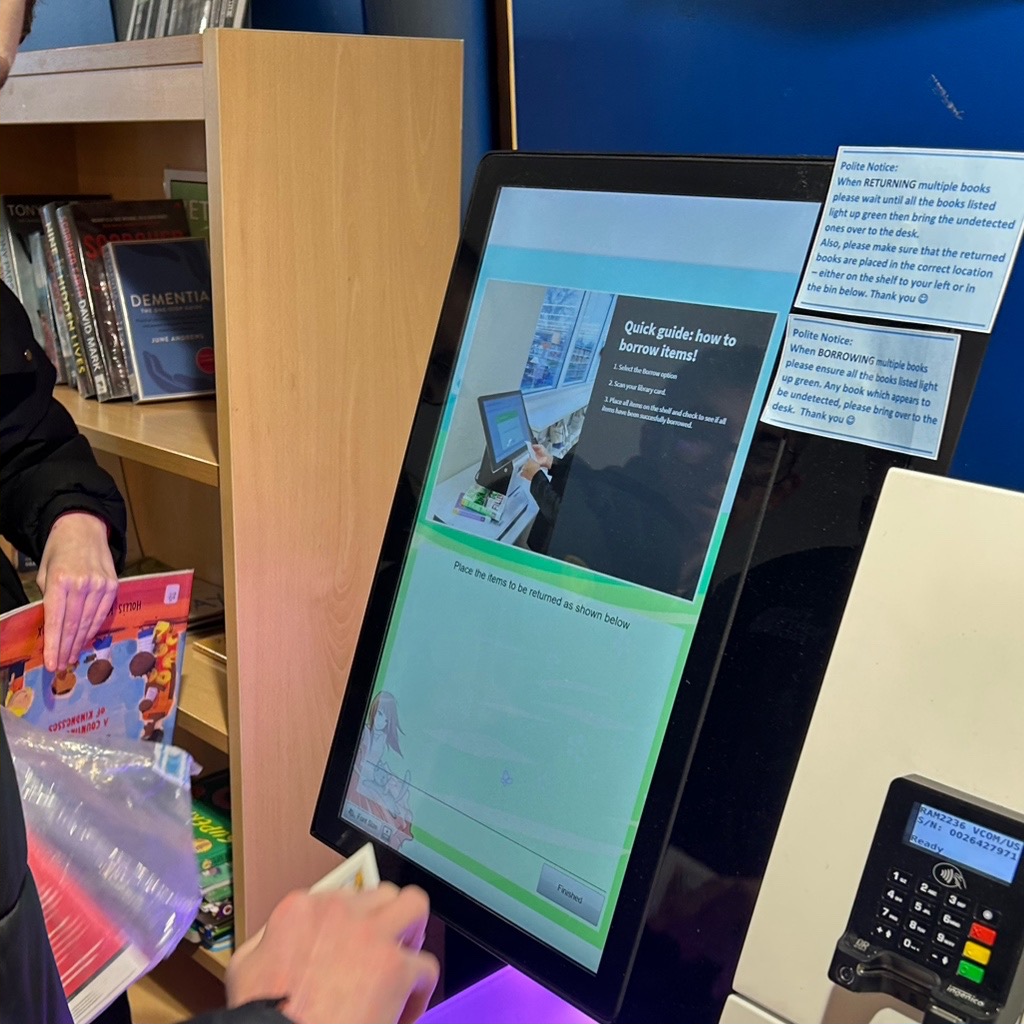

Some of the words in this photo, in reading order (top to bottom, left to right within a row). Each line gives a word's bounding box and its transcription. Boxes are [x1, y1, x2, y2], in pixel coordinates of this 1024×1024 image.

[840, 161, 865, 171] Polite
[866, 162, 898, 172] Notice:
[838, 177, 862, 186] When
[863, 177, 917, 189] RETURNING
[918, 181, 958, 193] multiple
[960, 182, 990, 193] books
[832, 193, 860, 203] please
[862, 195, 881, 203] wait
[882, 196, 904, 204] until
[904, 197, 917, 205] all
[918, 198, 934, 207] the
[936, 198, 965, 208] books
[967, 200, 997, 211] listed
[829, 208, 848, 218] light
[849, 210, 861, 220] up
[861, 211, 887, 220] green
[889, 212, 910, 221] then
[911, 213, 936, 225] bring
[938, 215, 954, 224] the
[956, 217, 1016, 229] undetected
[825, 224, 845, 232] ones
[846, 226, 866, 234] over
[868, 226, 877, 235] to
[879, 227, 894, 236] the
[895, 228, 919, 238] desk.
[820, 238, 840, 249] Also,
[842, 240, 871, 250] please
[872, 243, 896, 252] make
[898, 246, 918, 254] sure
[920, 246, 940, 256] that
[942, 248, 958, 258] the
[960, 250, 1006, 262] returned
[816, 252, 842, 263] books
[843, 257, 857, 265] are
[858, 257, 889, 268] placed
[889, 259, 898, 268] in
[900, 261, 915, 270] the
[917, 264, 951, 274] correct
[952, 265, 993, 278] location
[807, 282, 822, 292] the
[823, 283, 837, 294] bin
[838, 285, 867, 297] below.
[870, 289, 897, 300] Thank
[898, 294, 916, 303] you
[819, 269, 845, 279] either
[859, 273, 874, 282] the
[875, 275, 898, 284] shelf
[899, 277, 909, 286] to
[910, 279, 932, 289] your
[934, 280, 950, 290] left
[965, 283, 975, 293] in
[130, 290, 210, 308] DEMENTIA
[78, 299, 93, 334] DAVID
[86, 336, 101, 371] MARK
[625, 320, 656, 336] Quick
[656, 326, 694, 340] guide:
[695, 330, 722, 344] how
[723, 334, 736, 346] to
[792, 328, 818, 340] Polite
[820, 332, 853, 346] Notice:
[619, 339, 660, 356] borrow
[660, 345, 698, 362] items!
[790, 343, 816, 355] When
[818, 347, 875, 365] BORROWING
[876, 358, 905, 370] multiple
[906, 361, 928, 373] books
[785, 360, 814, 371] please
[815, 365, 845, 376] ensure
[846, 369, 858, 378] all
[859, 371, 874, 381] the
[875, 373, 897, 384] books
[898, 376, 918, 388] listed
[919, 379, 938, 392] light
[782, 375, 793, 384] up
[794, 377, 822, 388] green.
[823, 380, 841, 393] Any
[842, 383, 864, 395] book
[867, 388, 890, 400] which
[891, 393, 919, 405] appears
[921, 397, 931, 406] to
[772, 402, 795, 413] desk.
[800, 407, 827, 420] Thank
[828, 414, 844, 423] you
[777, 387, 789, 397] be
[843, 400, 871, 413] please
[873, 404, 894, 419] bring
[894, 410, 911, 420] over
[912, 412, 921, 422] to
[923, 414, 937, 424] the
[453, 561, 473, 575] Place
[474, 568, 486, 579] the
[487, 572, 507, 587] items
[508, 579, 516, 590] to
[517, 582, 527, 594] be
[529, 588, 562, 606] returned
[563, 600, 573, 610] as
[575, 604, 602, 620] shown
[604, 612, 630, 629] below
[920, 806, 966, 830] RAM2236
[911, 834, 944, 854] Ready
[917, 816, 942, 831] S/N:
[949, 828, 1017, 860] 0026427971
[946, 984, 985, 1007] ingenico
